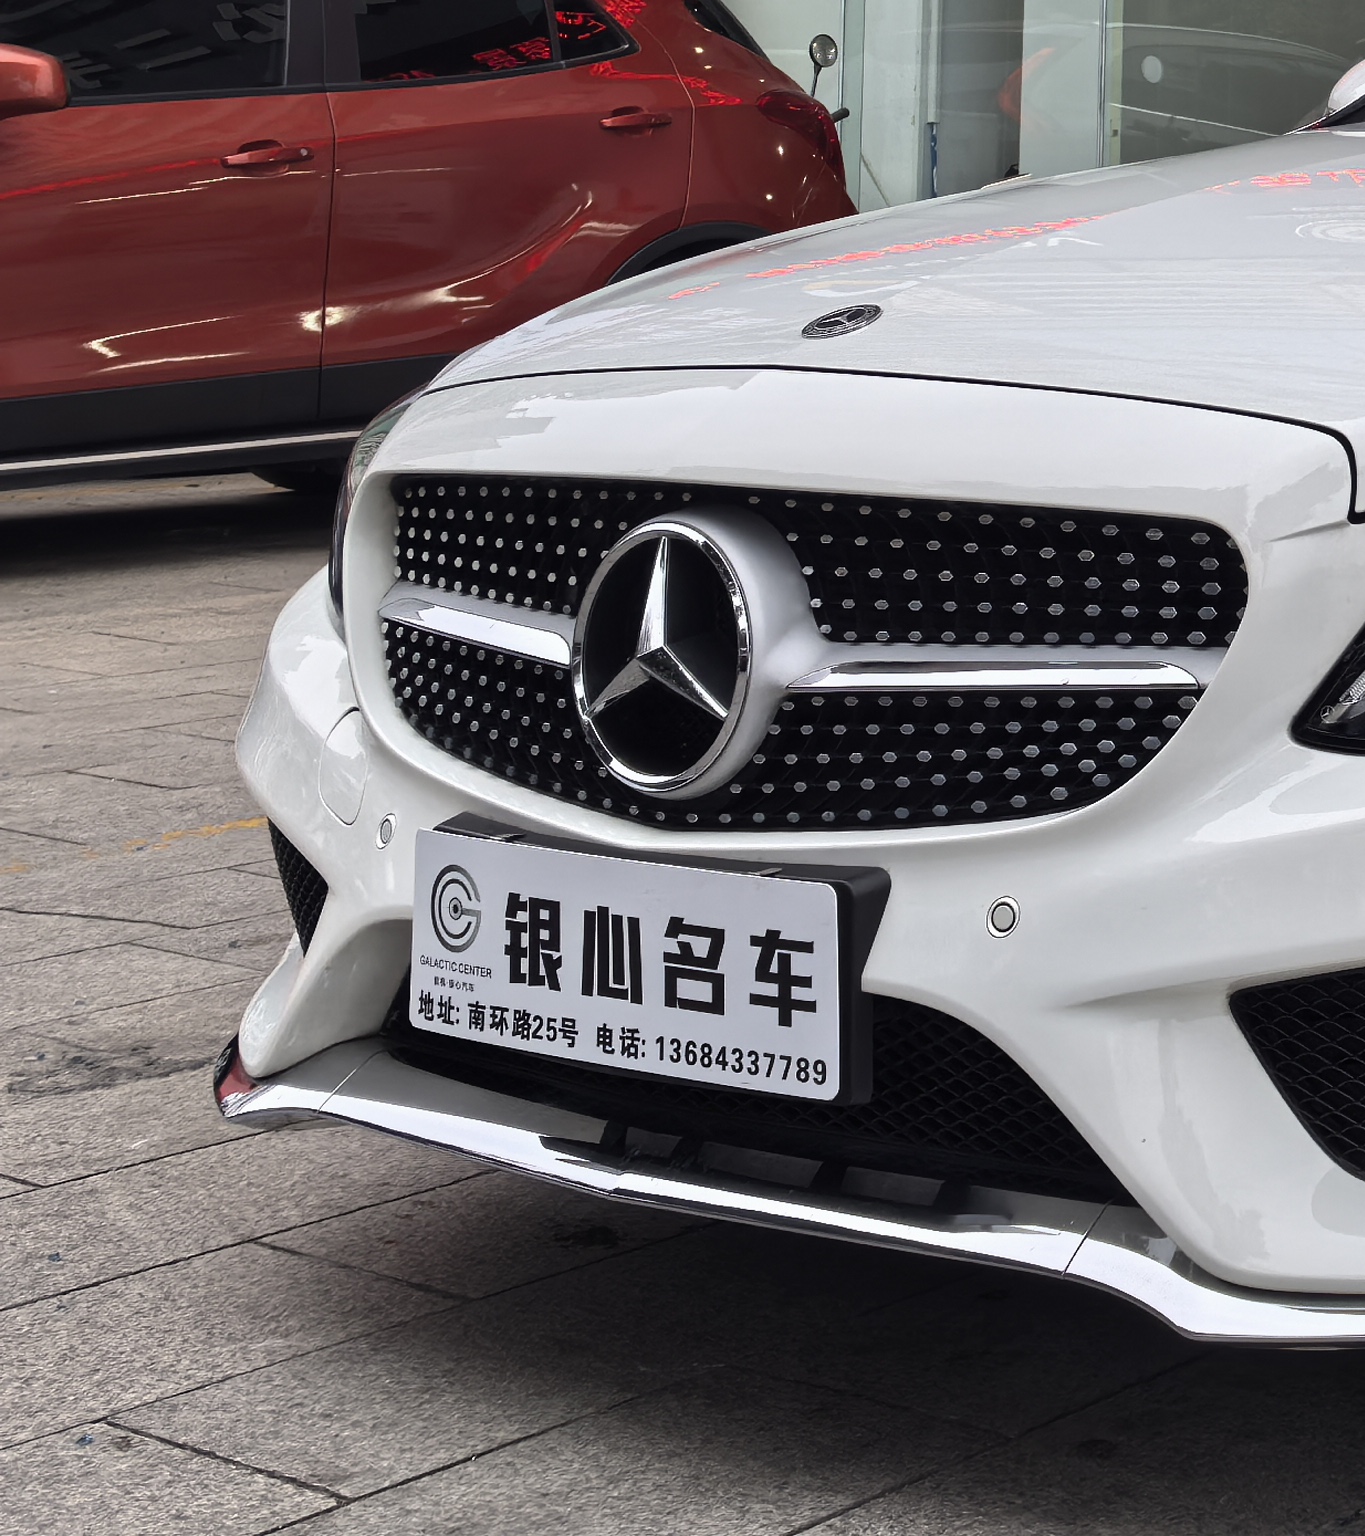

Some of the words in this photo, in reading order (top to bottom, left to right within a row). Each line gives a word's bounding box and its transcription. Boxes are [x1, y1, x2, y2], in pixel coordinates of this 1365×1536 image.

[420, 954, 458, 972] GALACTIC
[458, 963, 492, 979] CENTER
[504, 891, 817, 1029] 银心名车
[467, 1000, 579, 1049] 南环路25号
[655, 1036, 828, 1086] 13684337789
